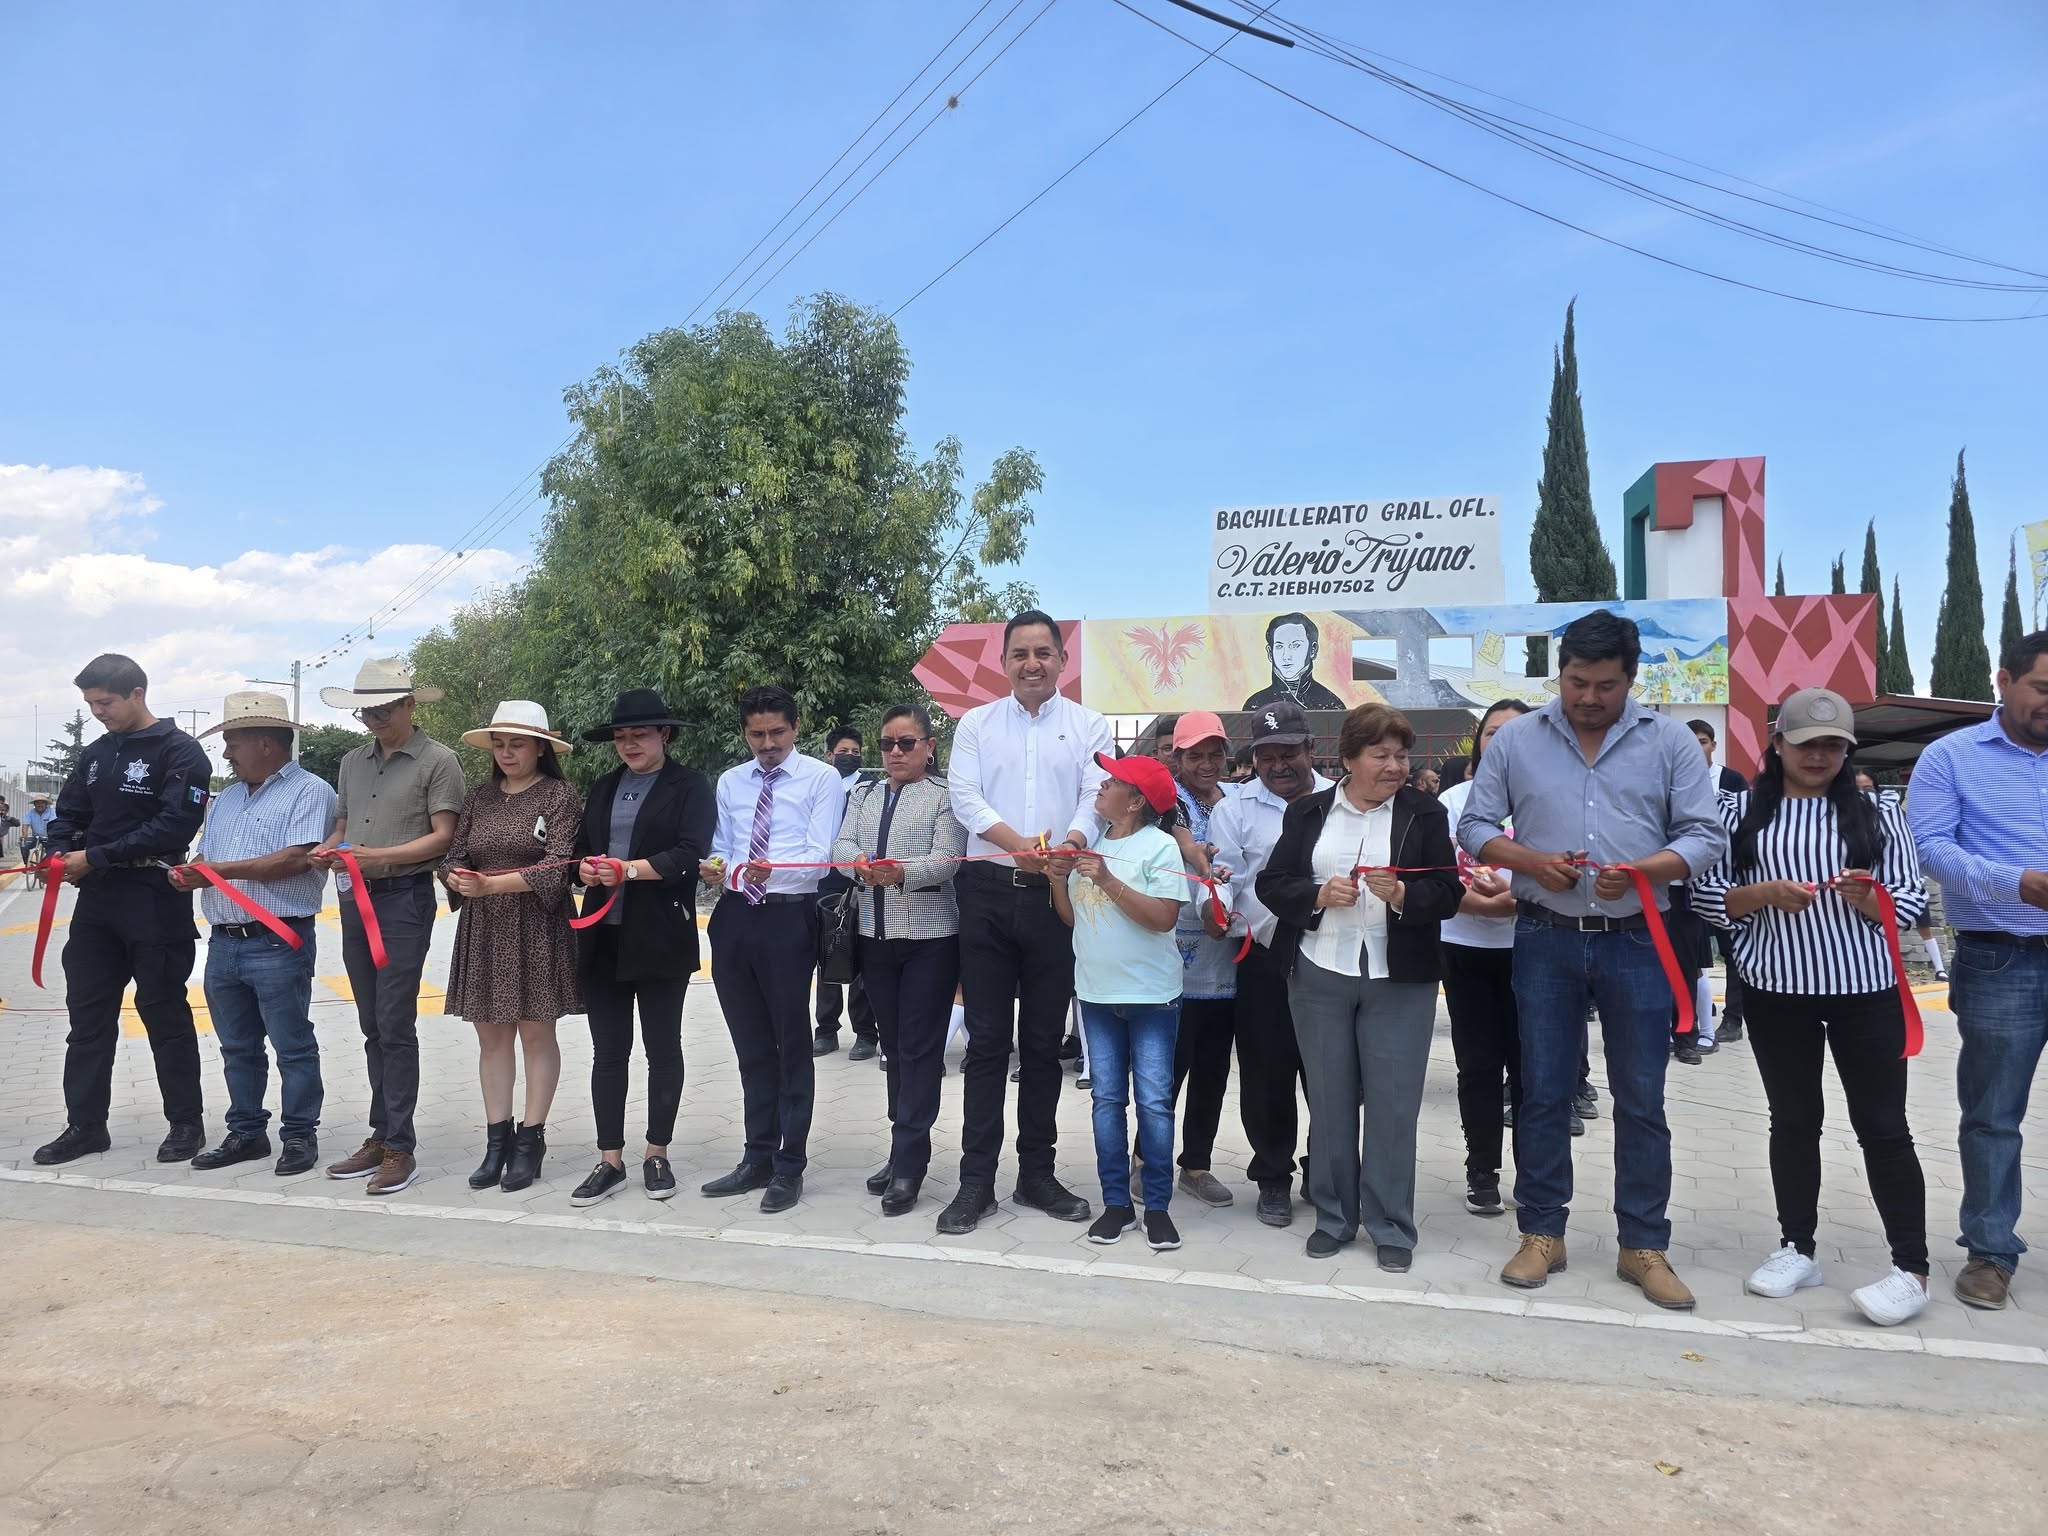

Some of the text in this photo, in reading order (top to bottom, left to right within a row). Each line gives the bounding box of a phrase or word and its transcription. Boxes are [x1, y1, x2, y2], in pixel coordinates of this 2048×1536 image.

[1216, 498, 1495, 530] BACHILLERATO GRAL. OFL.
[1217, 538, 1345, 577] Valerio
[1217, 582, 1263, 598] C.C.T.
